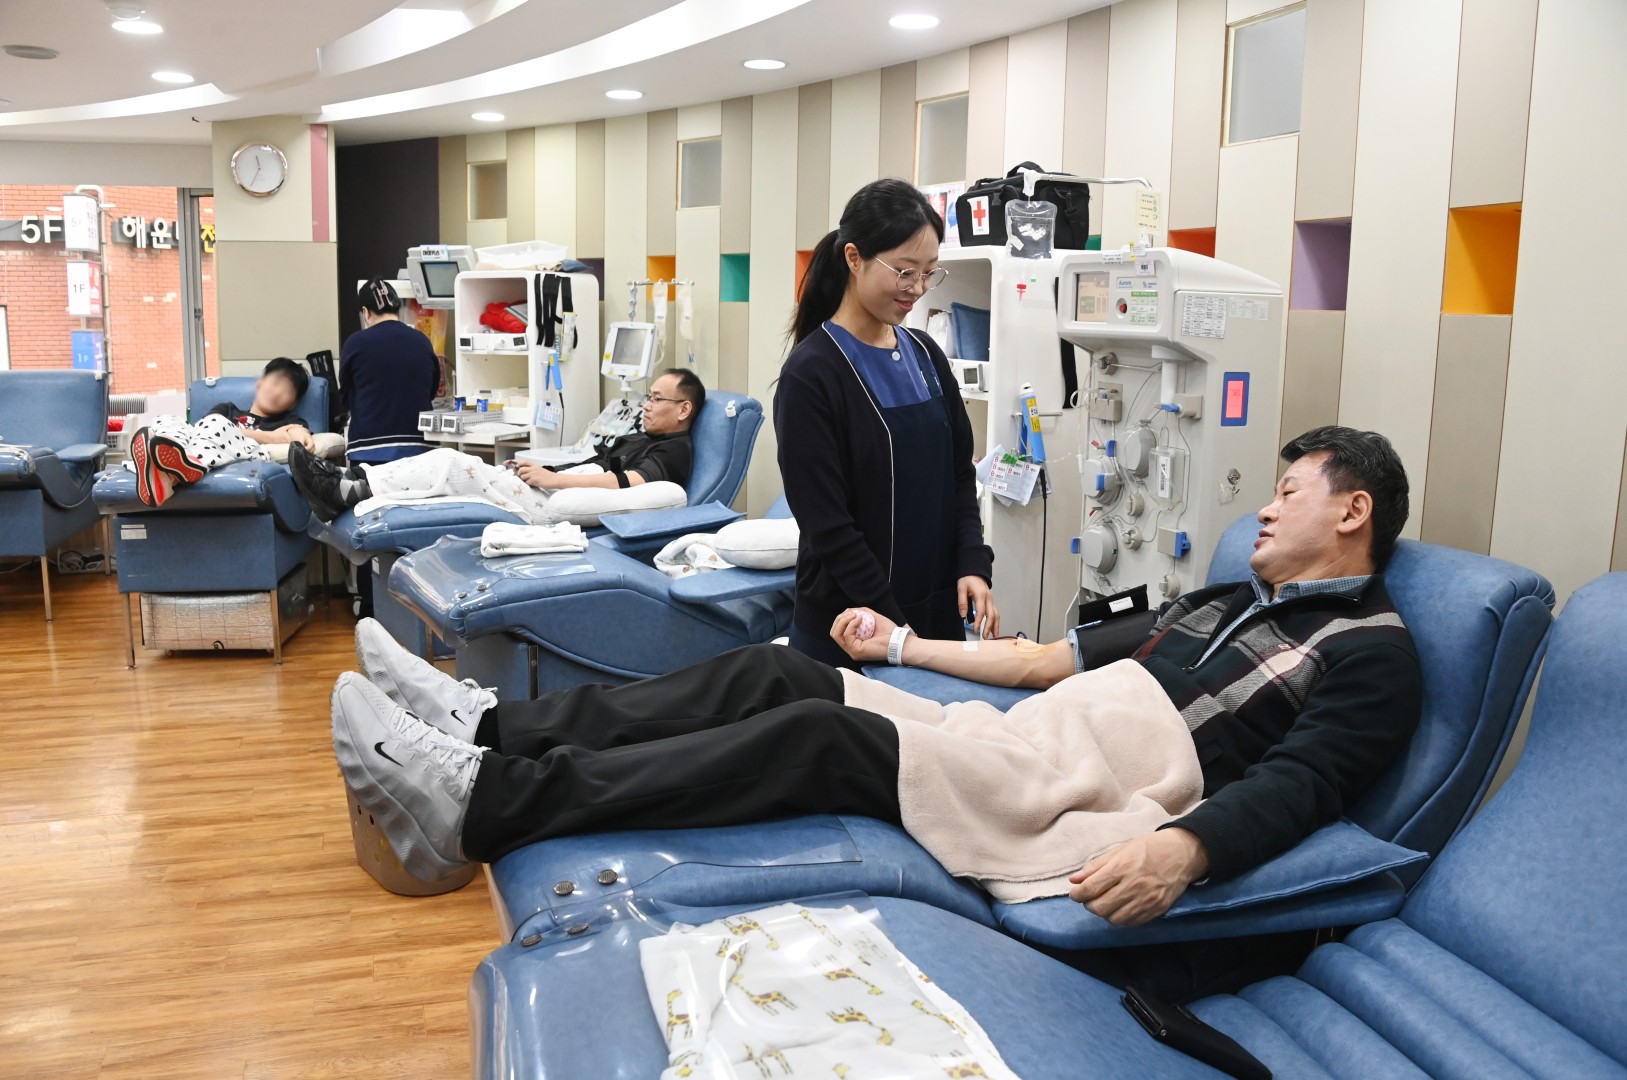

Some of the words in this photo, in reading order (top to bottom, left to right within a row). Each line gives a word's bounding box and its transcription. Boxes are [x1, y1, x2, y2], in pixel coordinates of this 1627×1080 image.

[21, 215, 63, 243] 5F
[121, 216, 179, 249] 해운
[73, 284, 85, 293] 1F
[78, 353, 89, 363] 1F
